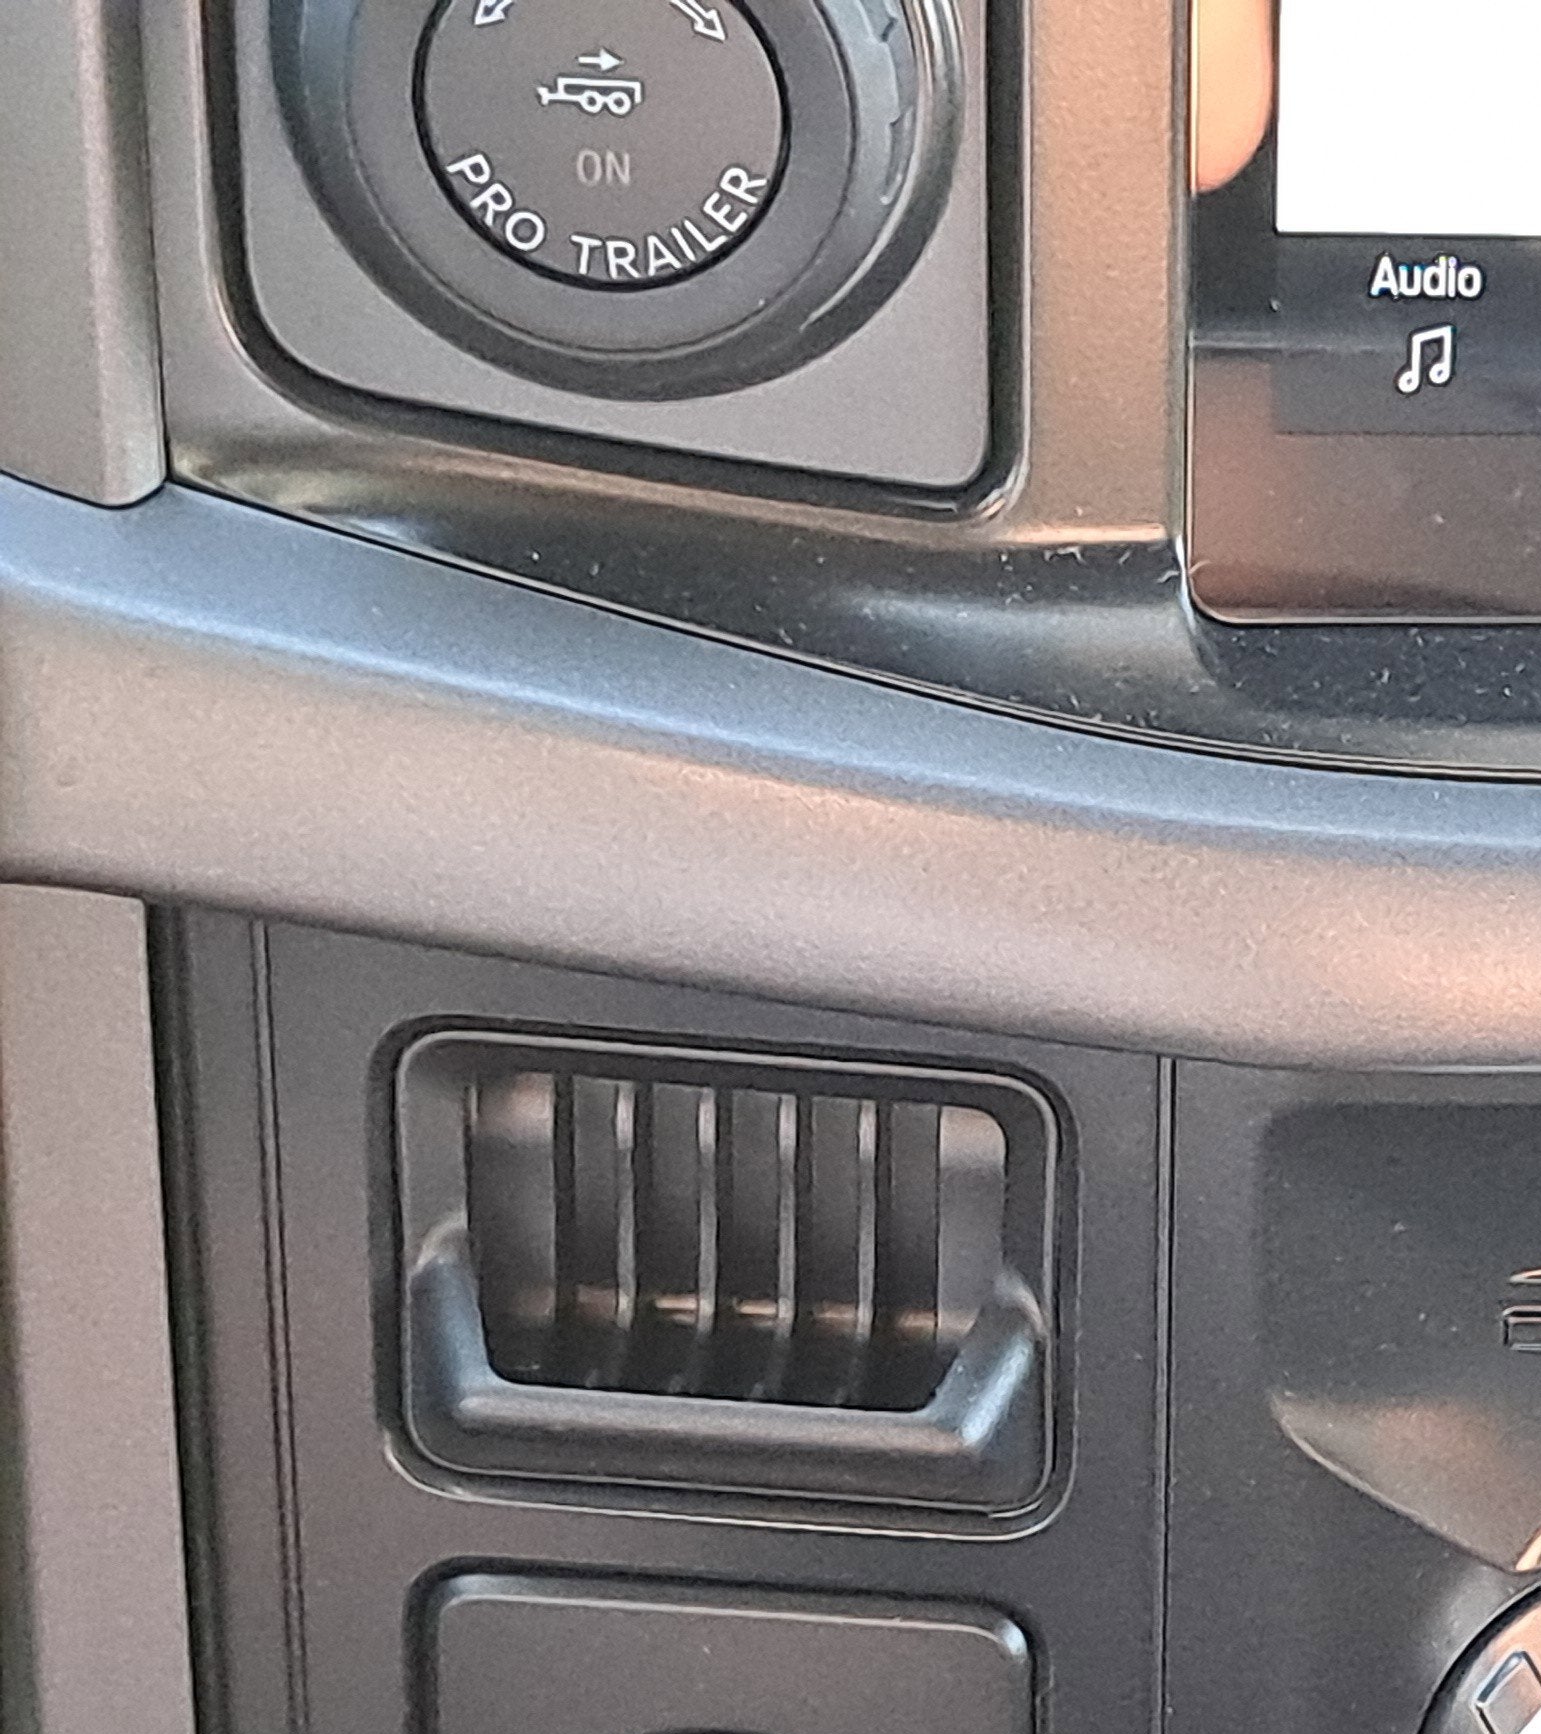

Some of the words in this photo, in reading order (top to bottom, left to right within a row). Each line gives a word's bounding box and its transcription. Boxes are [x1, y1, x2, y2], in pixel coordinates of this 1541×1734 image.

[577, 149, 632, 186] ON
[447, 153, 546, 252] PRO
[570, 167, 768, 278] TRAILER
[1370, 256, 1482, 300] Audio
